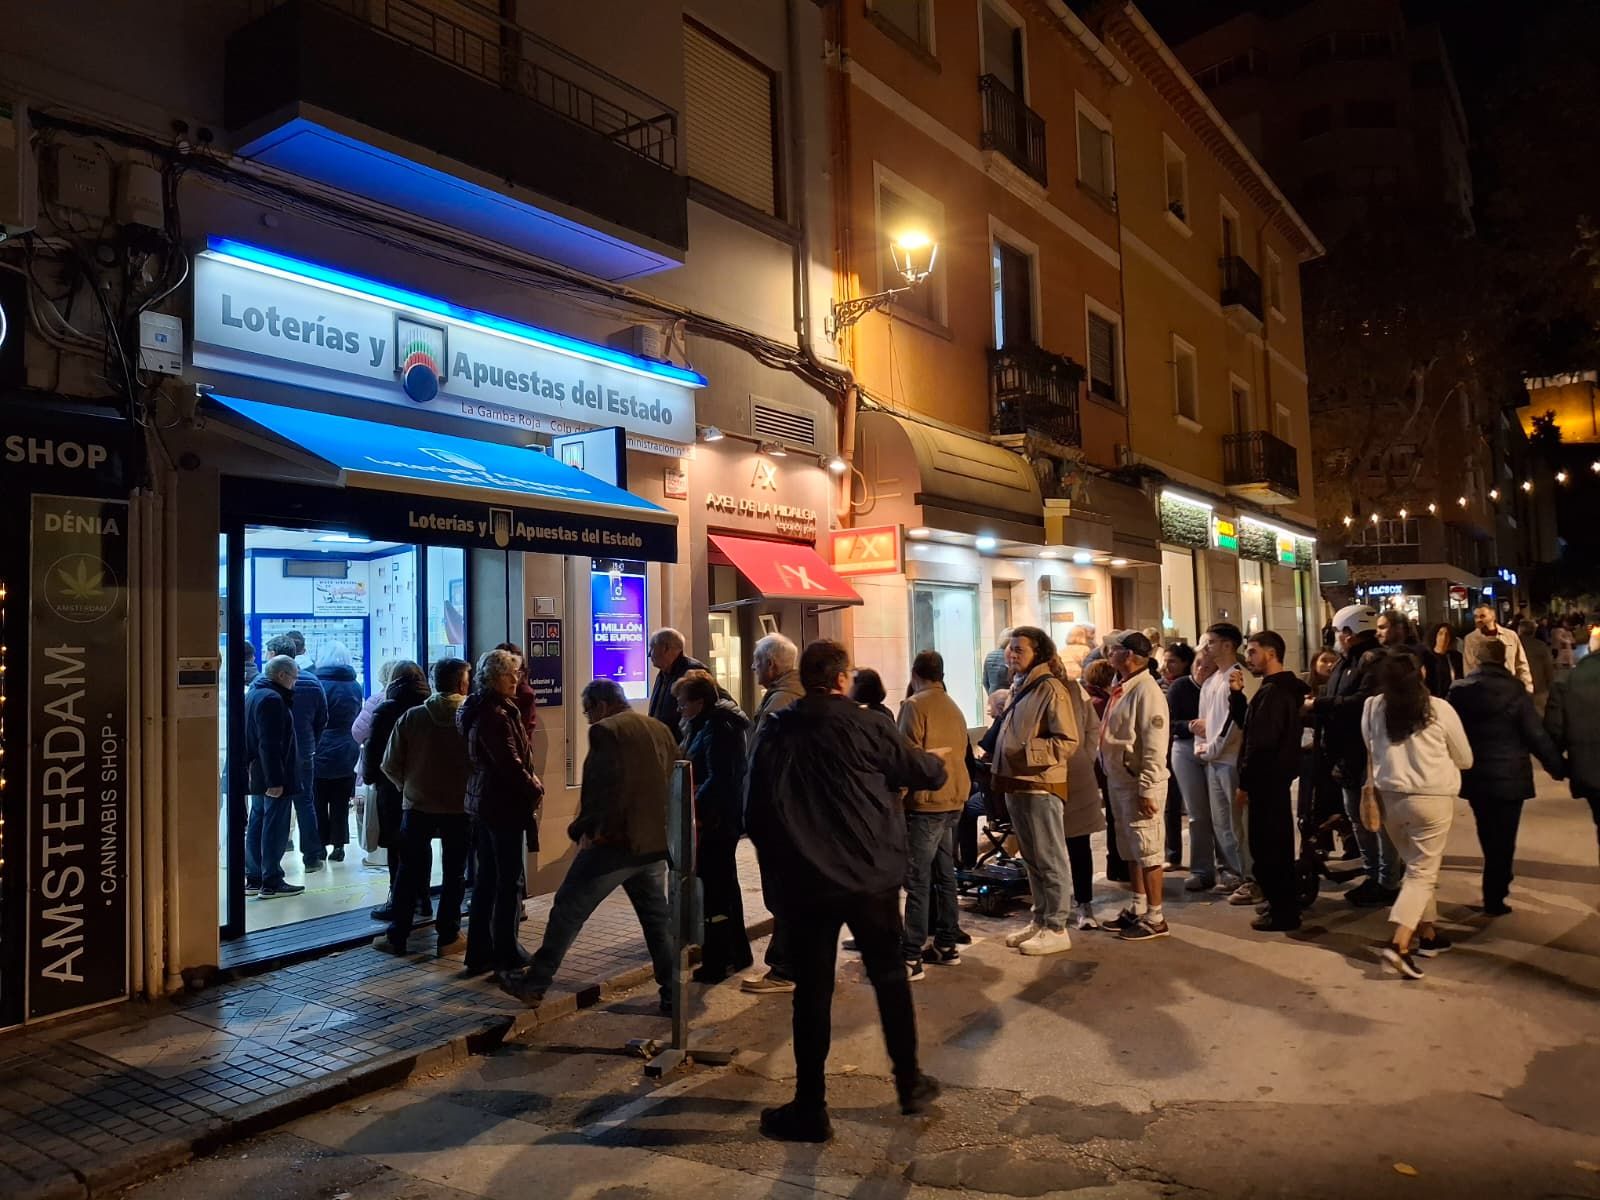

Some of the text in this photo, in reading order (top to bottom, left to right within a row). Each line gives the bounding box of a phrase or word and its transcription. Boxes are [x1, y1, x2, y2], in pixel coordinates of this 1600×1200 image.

[221, 293, 673, 425] Loterías y Apuestas del Estado
[461, 402, 541, 429] La Gamba Roja
[4, 434, 108, 469] SHOP
[705, 492, 736, 510] AXEL
[738, 498, 755, 514] DE
[757, 502, 771, 516] LA
[44, 509, 121, 536] DÉNIA
[408, 510, 643, 547] Loterías y Apuestas del Estado
[594, 621, 643, 633] 1 MILLÓN
[595, 633, 643, 643] DE EUROS
[41, 642, 86, 984] AMSTERDAM
[100, 725, 118, 893] CANNABIS SHOP
